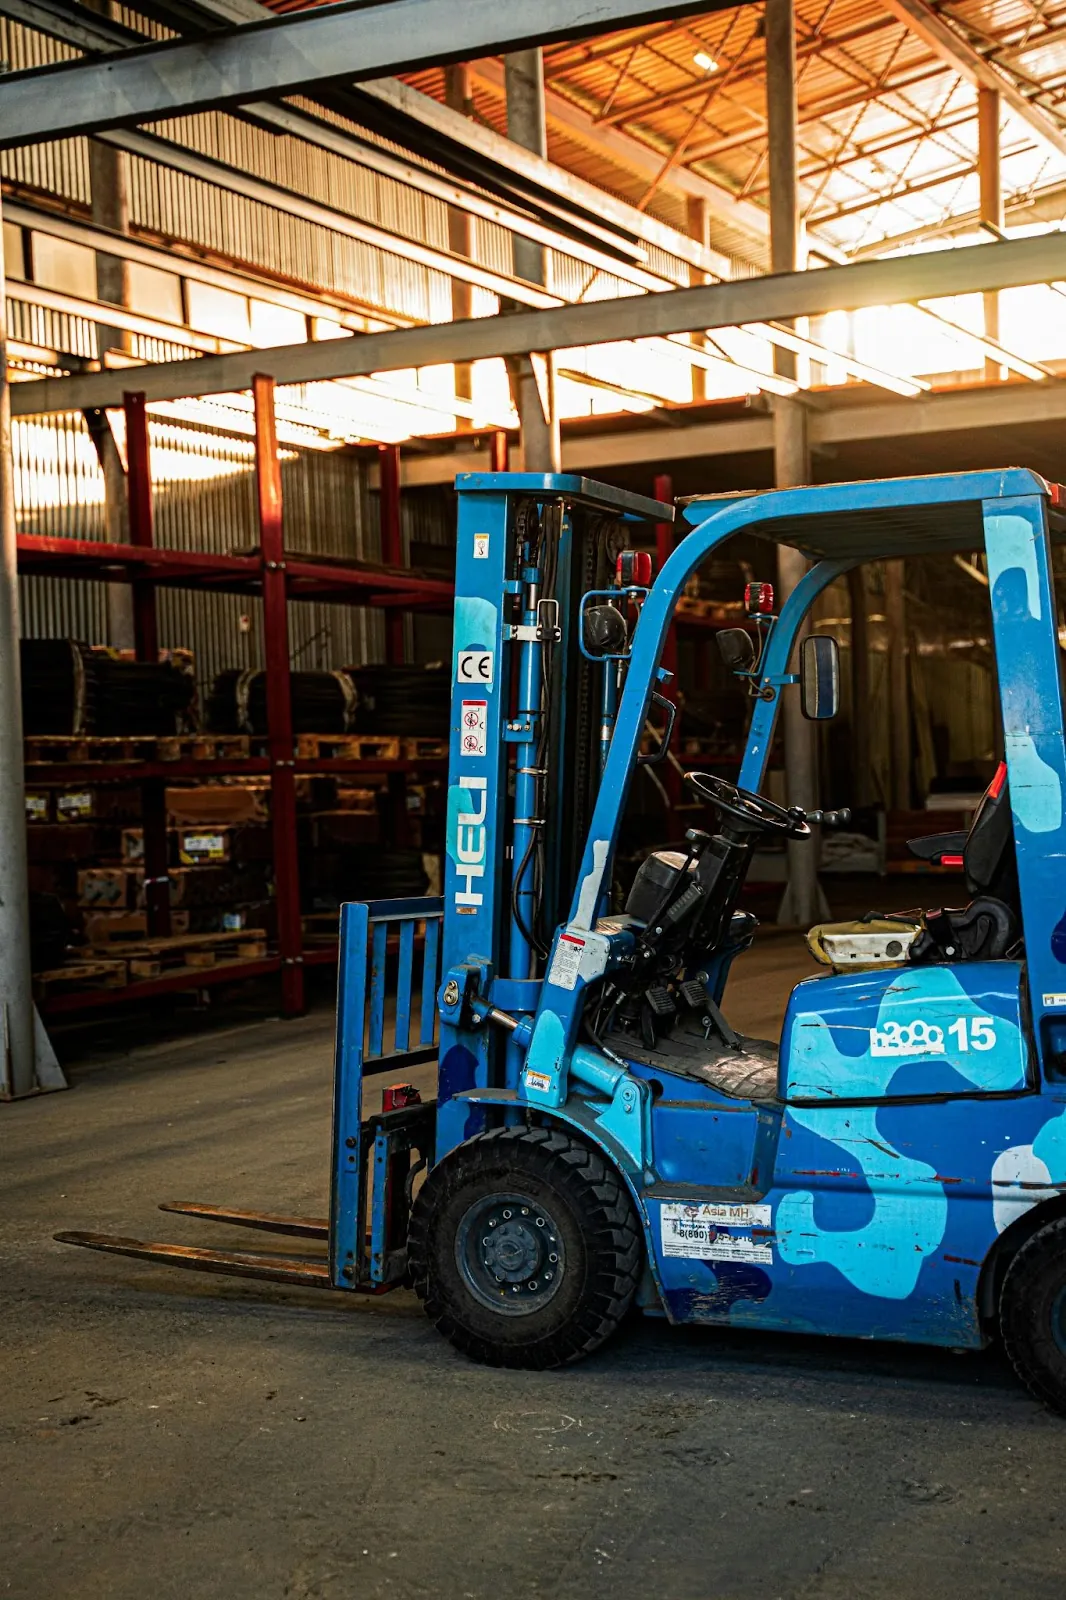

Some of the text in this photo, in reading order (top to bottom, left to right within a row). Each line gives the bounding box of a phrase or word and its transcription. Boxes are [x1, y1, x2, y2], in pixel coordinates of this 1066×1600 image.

[461, 656, 490, 678] CE
[455, 776, 487, 905] HELI
[948, 1016, 997, 1052] 15
[702, 1205, 749, 1218] Asia MH
